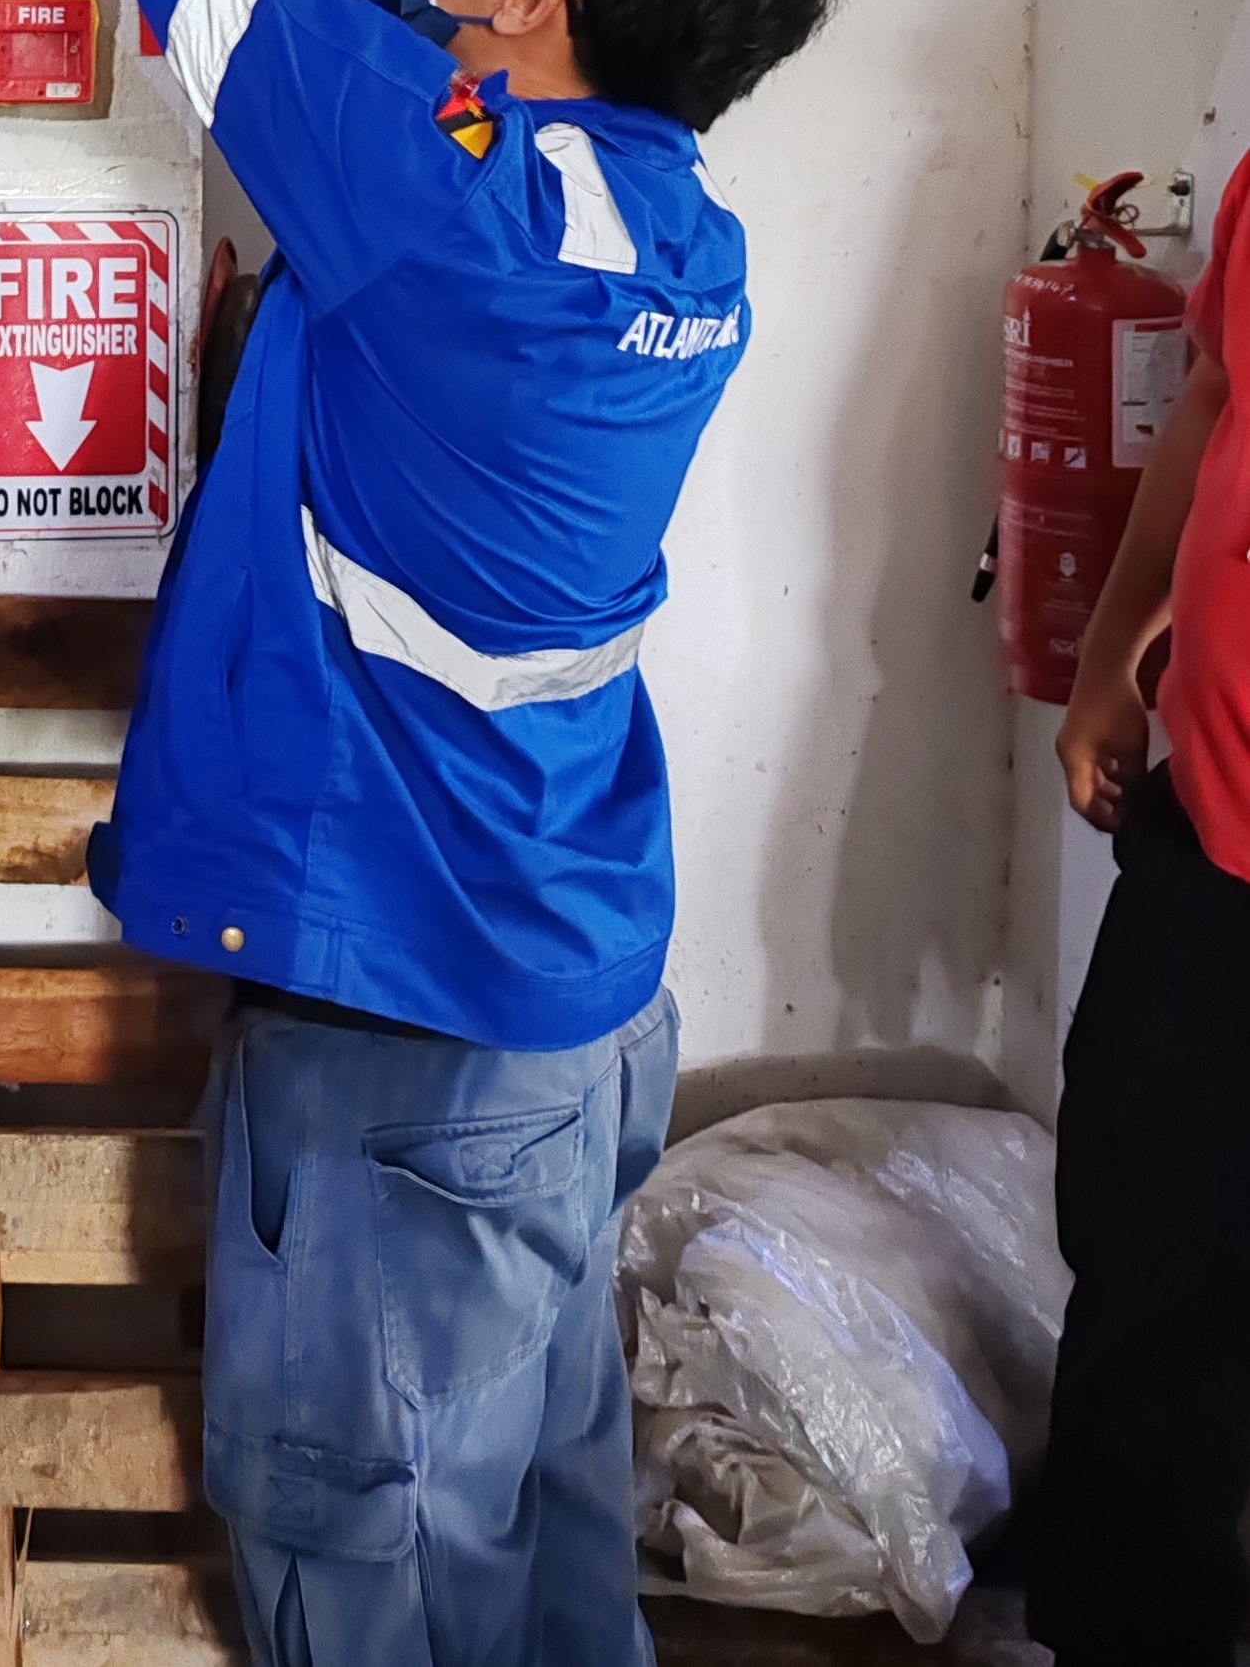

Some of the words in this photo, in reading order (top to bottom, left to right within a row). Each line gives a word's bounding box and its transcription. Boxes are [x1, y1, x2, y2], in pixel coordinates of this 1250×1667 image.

[18, 7, 65, 24] FIRE
[17, 487, 62, 516] NOT
[69, 485, 144, 516] BLOCK
